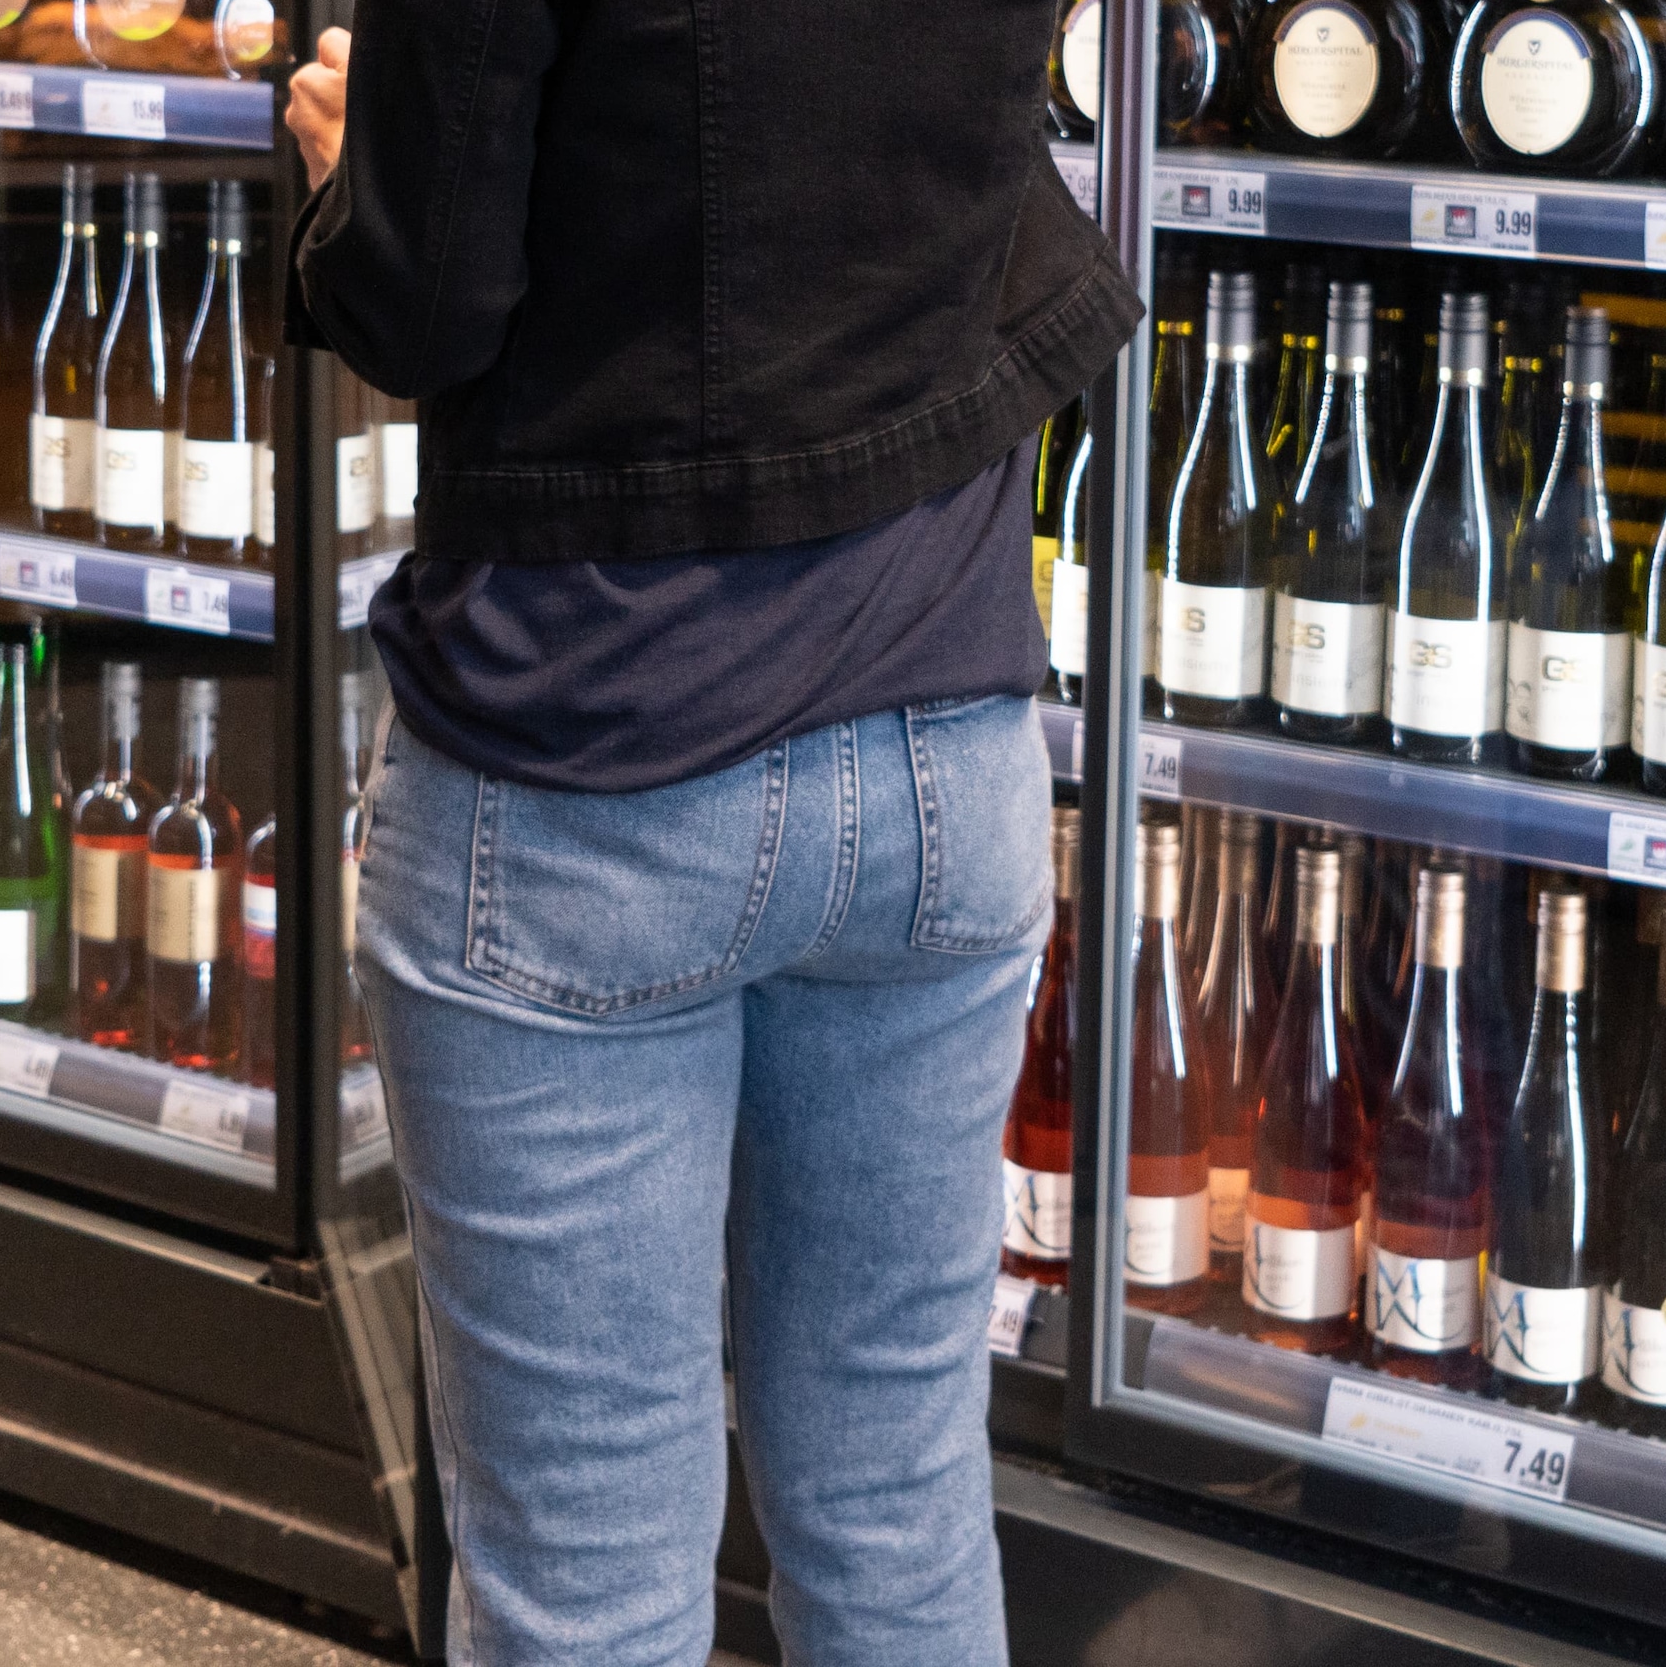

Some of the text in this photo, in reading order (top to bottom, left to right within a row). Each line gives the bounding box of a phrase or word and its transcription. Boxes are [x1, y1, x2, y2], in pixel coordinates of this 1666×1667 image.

[1228, 188, 1262, 215] 9.99
[1495, 209, 1532, 236] 9.99
[1144, 752, 1177, 780] 7.49
[1504, 1440, 1566, 1487] 7.49
